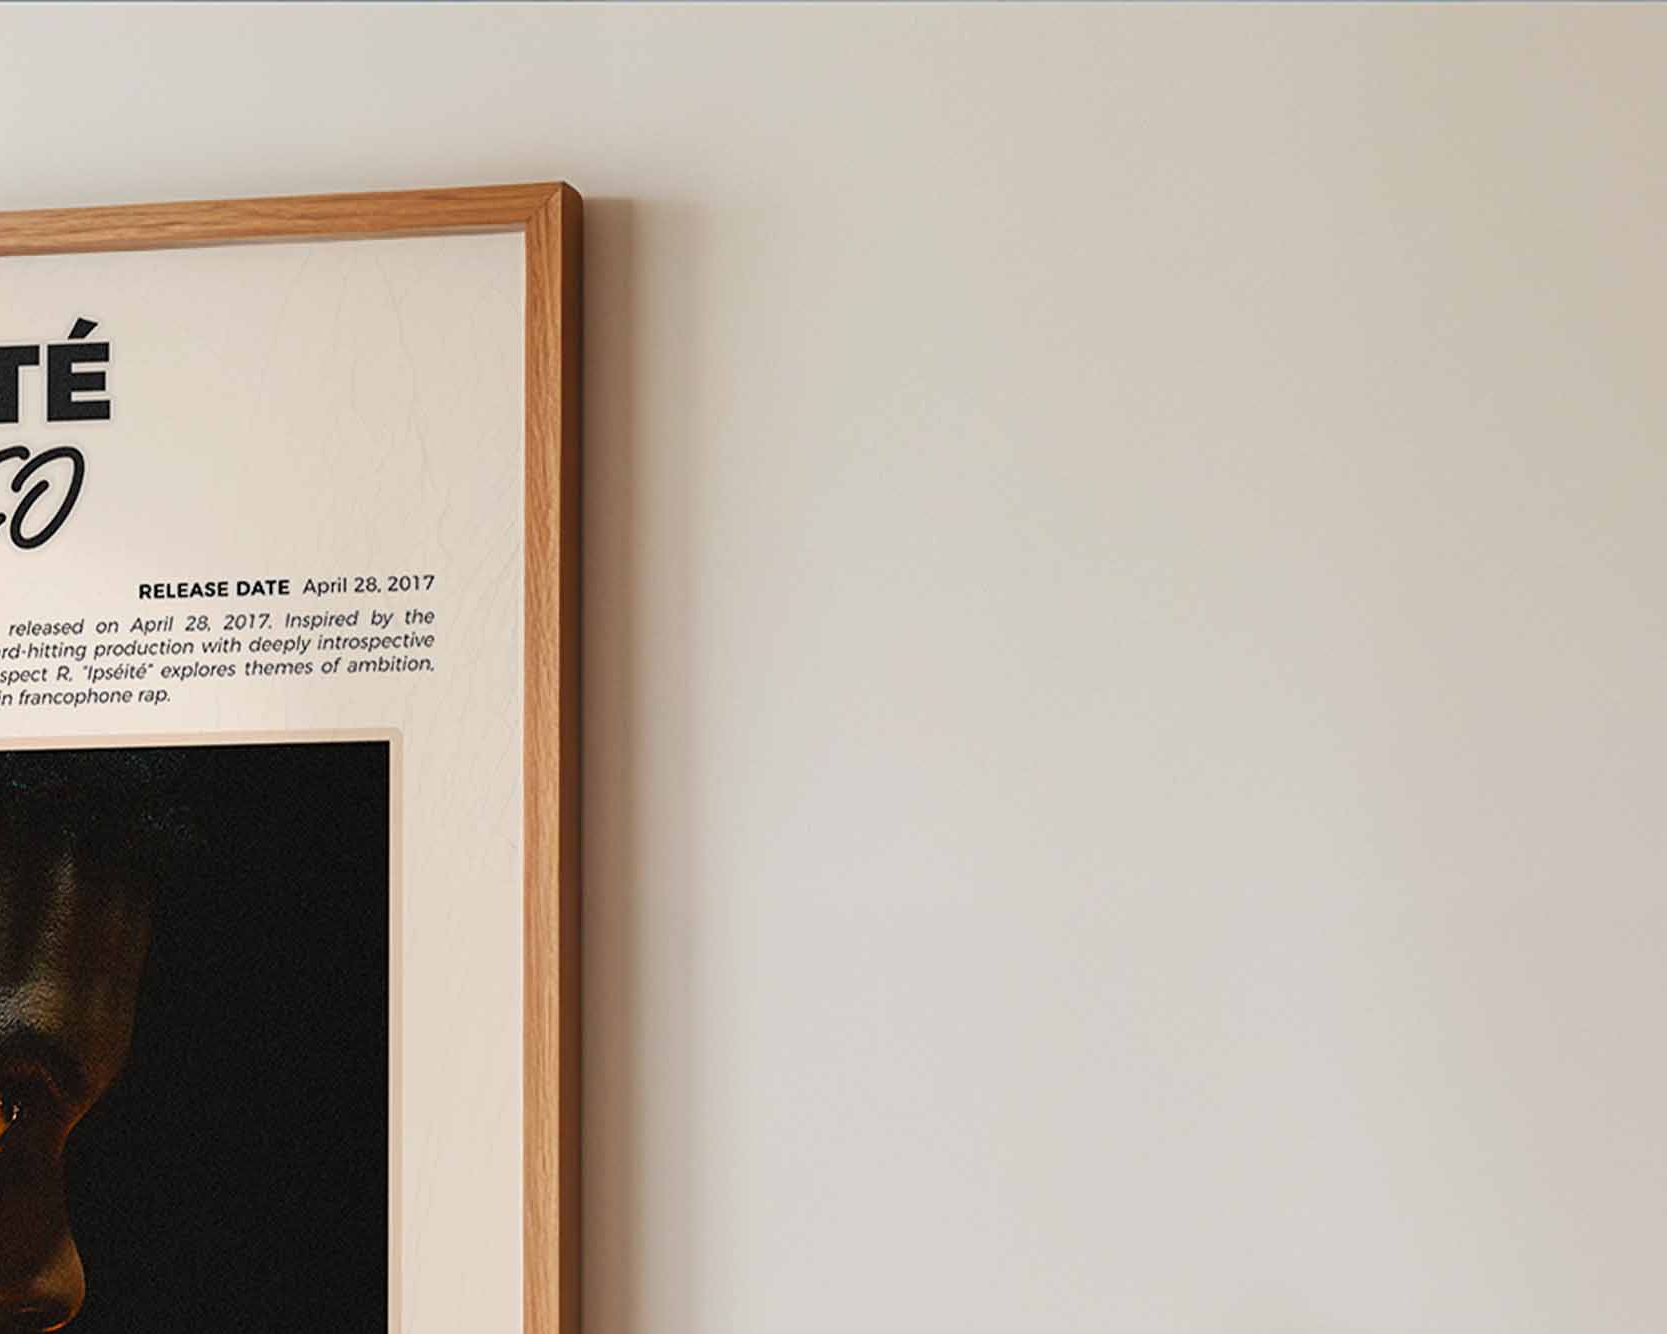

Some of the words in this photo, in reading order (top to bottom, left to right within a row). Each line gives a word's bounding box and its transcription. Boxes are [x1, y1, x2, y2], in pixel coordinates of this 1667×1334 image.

[139, 581, 229, 599] RELEASE
[237, 579, 290, 597] DATE
[303, 577, 347, 597] April
[388, 575, 434, 592] 2017
[9, 619, 84, 637] released
[96, 621, 119, 634] on
[130, 616, 173, 636] April
[224, 613, 271, 630] 2017.
[285, 610, 359, 630] Inspired
[371, 610, 393, 629] by
[405, 609, 435, 625] the
[94, 639, 194, 660] production
[202, 637, 241, 653] with
[249, 635, 311, 655] deeply
[317, 632, 434, 652] introspective
[57, 665, 72, 682] R,
[161, 662, 235, 681] explores
[245, 660, 313, 676] themes
[321, 658, 340, 674] of
[347, 656, 434, 673] ambition,
[19, 689, 133, 708] francophone
[138, 690, 170, 706] rap.
